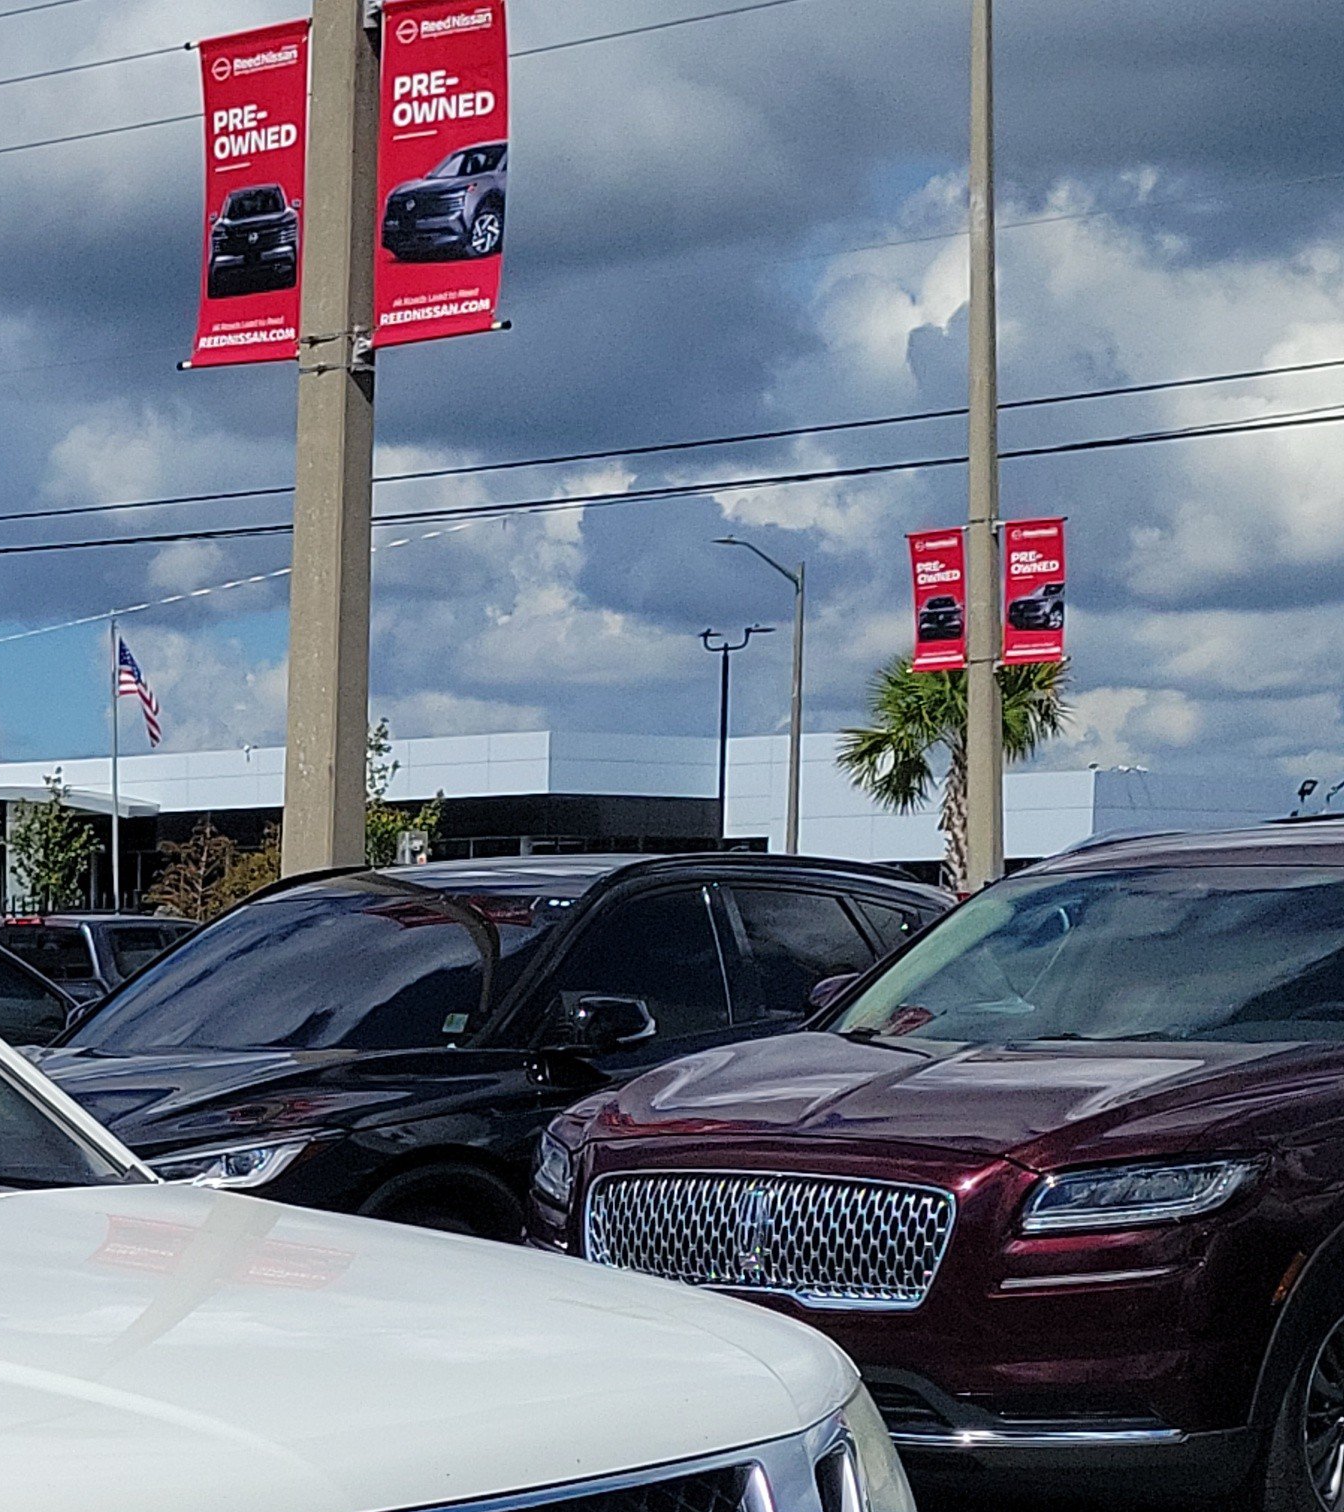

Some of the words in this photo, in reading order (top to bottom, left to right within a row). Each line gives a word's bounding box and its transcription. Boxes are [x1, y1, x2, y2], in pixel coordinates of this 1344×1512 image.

[394, 69, 459, 101] PRE-
[213, 103, 268, 135] PRE-
[393, 90, 496, 127] OWNED
[213, 123, 298, 160] OWNED
[379, 298, 491, 326] REEDNISSAN.COM
[198, 327, 297, 349] REEDNISSAN.COM
[915, 560, 946, 574] PRE-
[1010, 550, 1044, 564] PRE-
[1011, 560, 1060, 575] OWNED
[916, 569, 962, 585] OWNED
